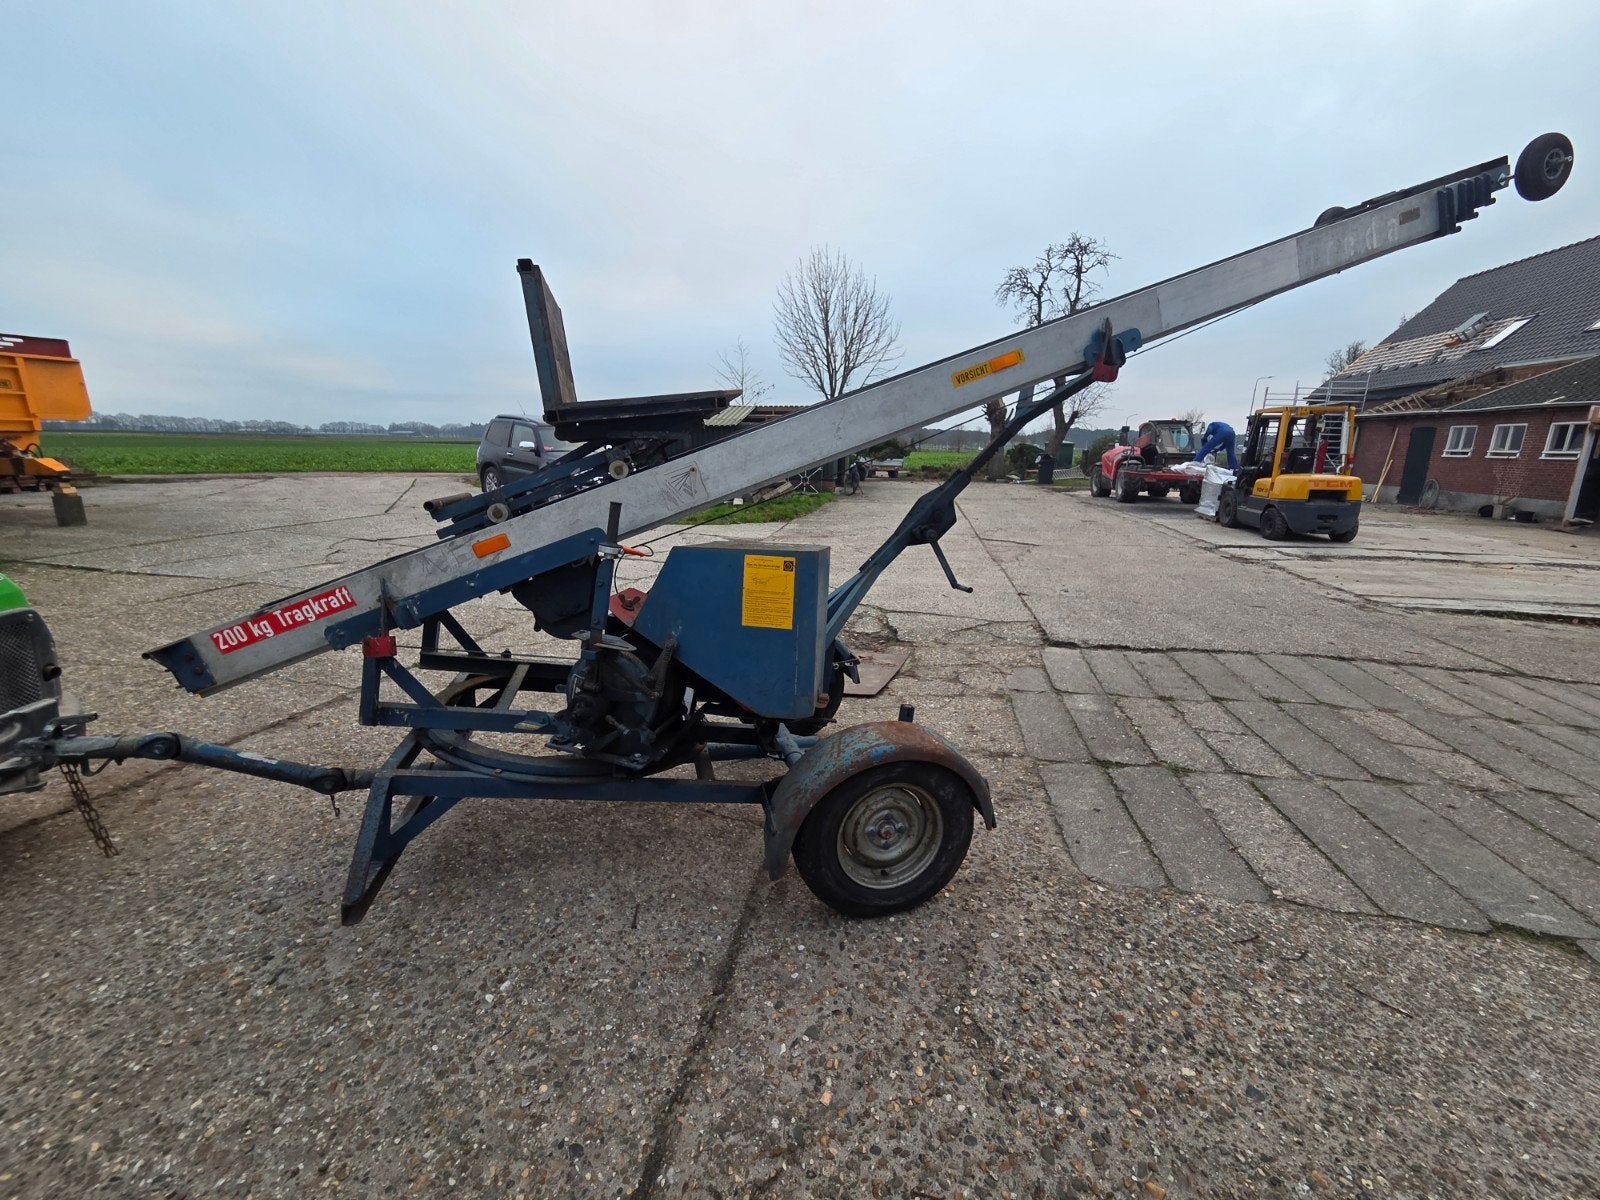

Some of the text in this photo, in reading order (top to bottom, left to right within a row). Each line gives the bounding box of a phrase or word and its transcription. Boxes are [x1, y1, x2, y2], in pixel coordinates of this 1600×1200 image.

[956, 364, 989, 384] VORSICHT
[213, 586, 352, 650] 200 kg Tragkraft
